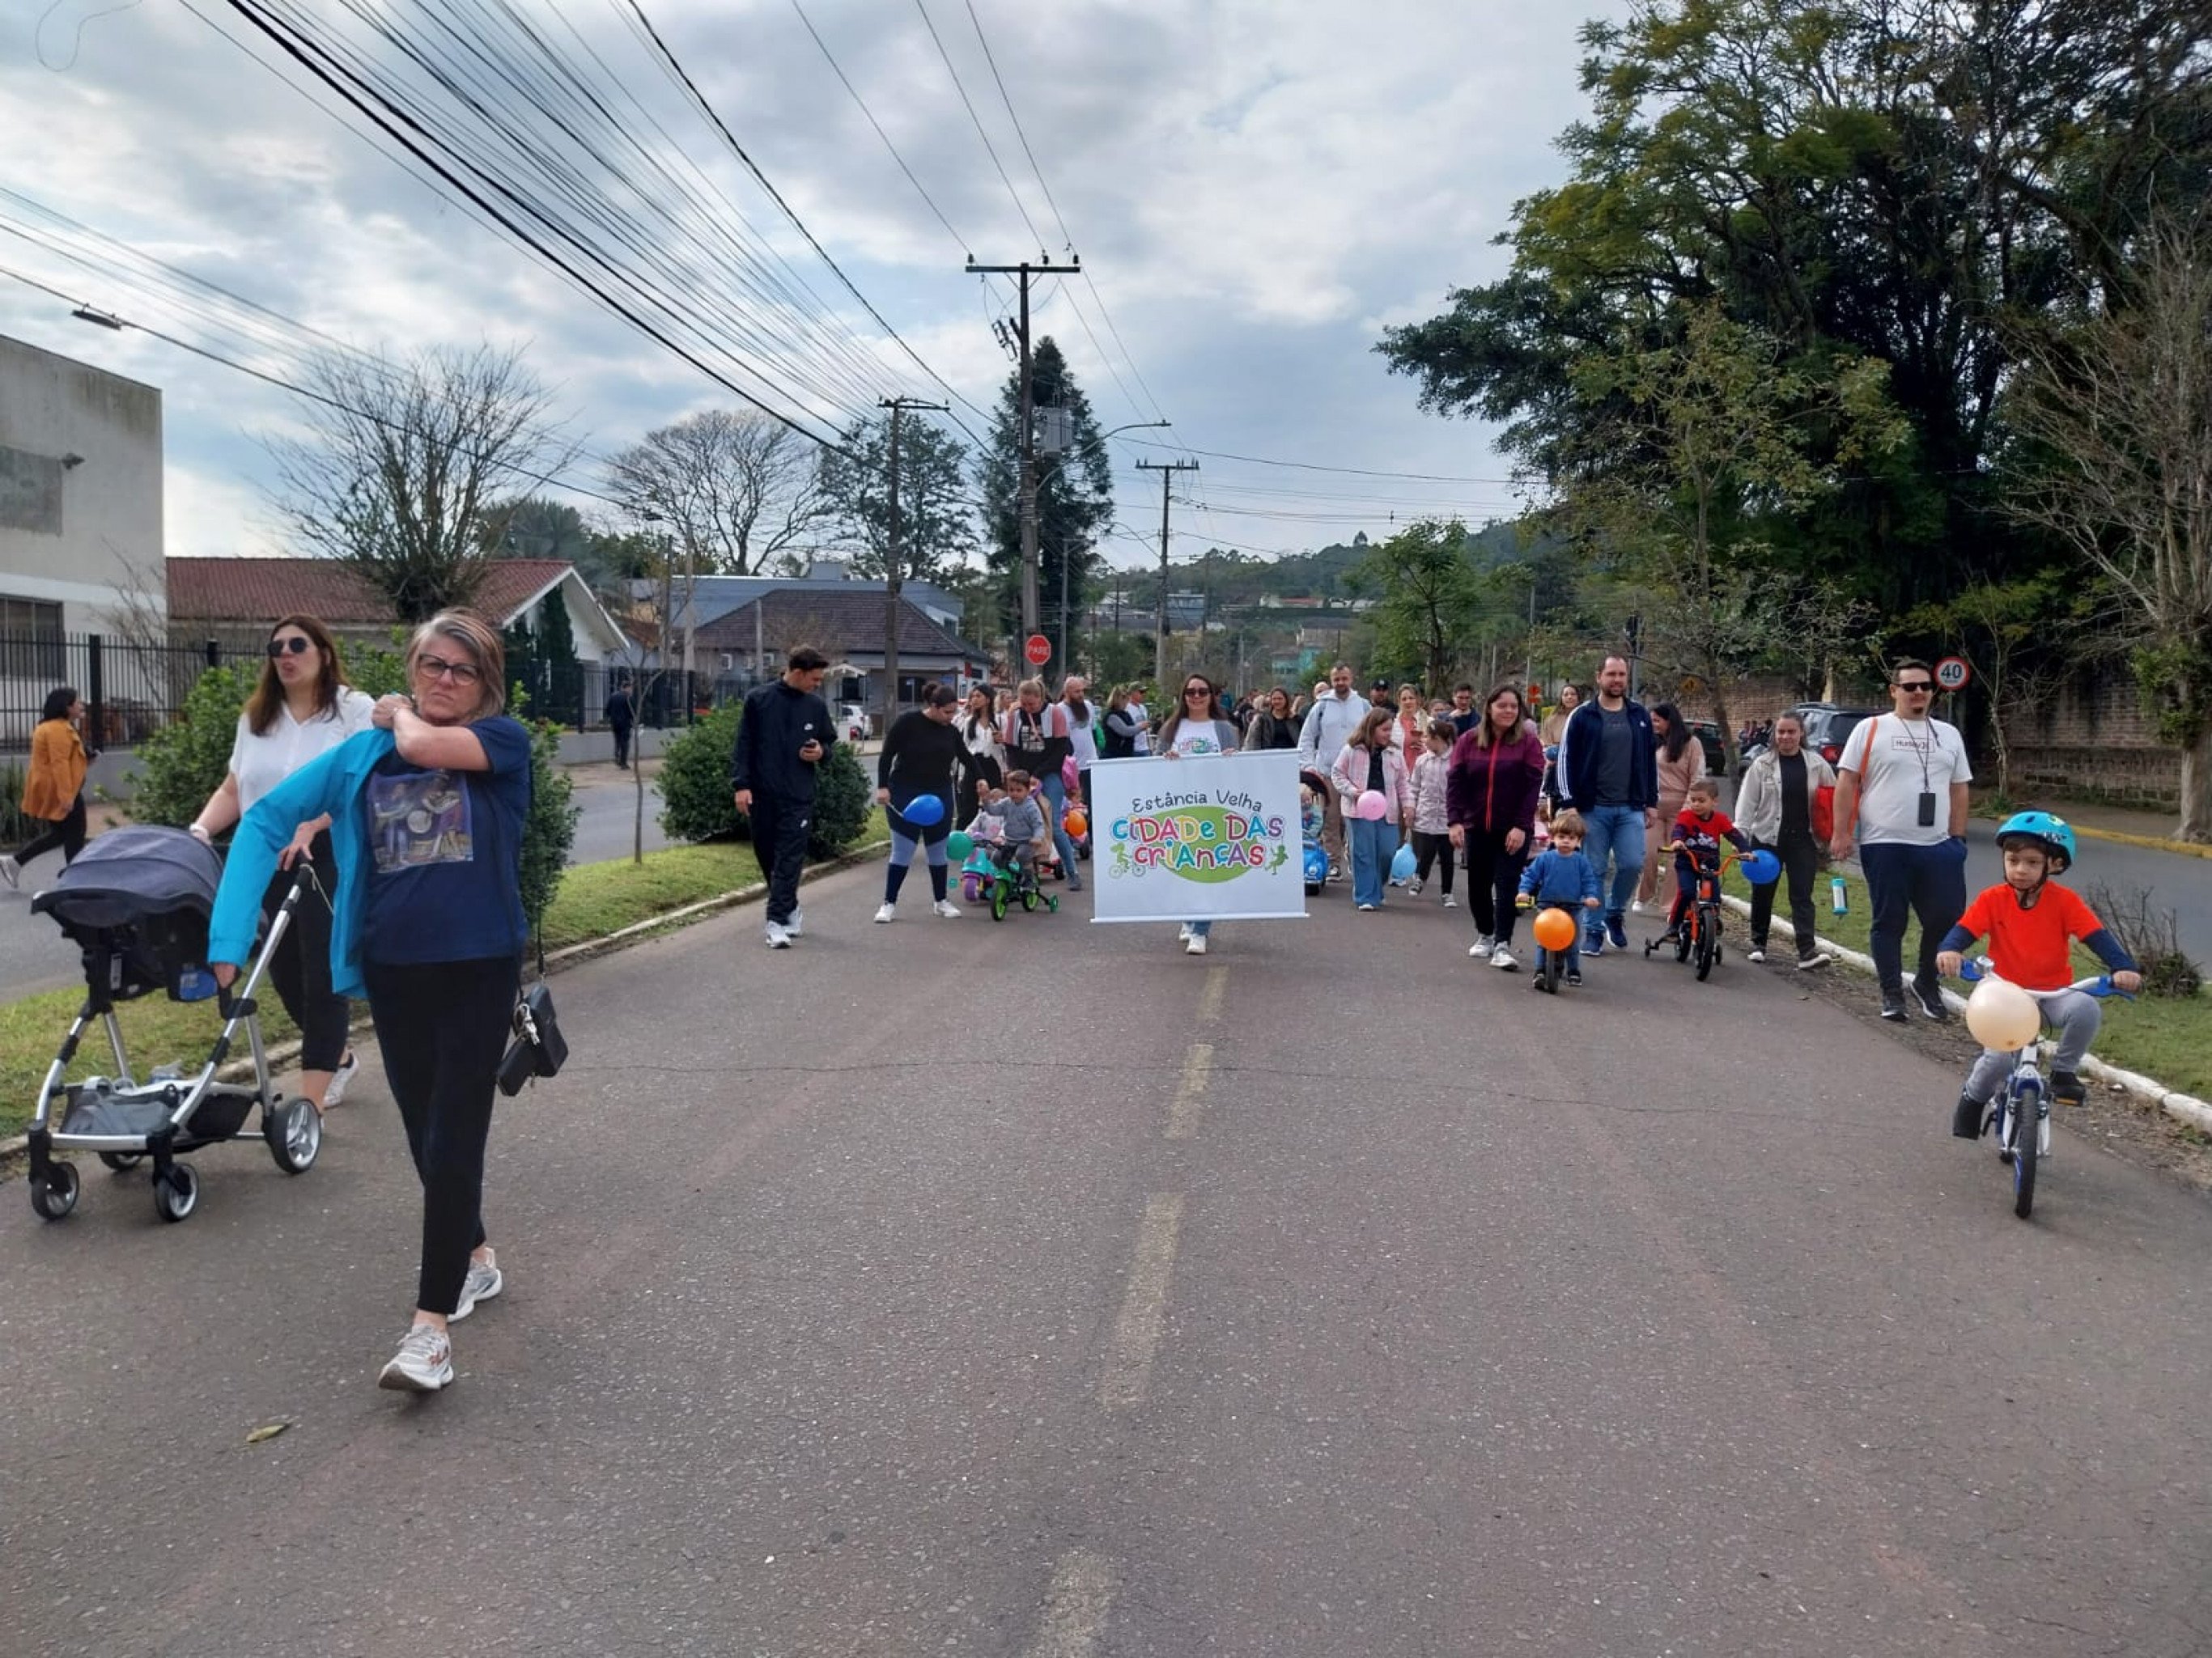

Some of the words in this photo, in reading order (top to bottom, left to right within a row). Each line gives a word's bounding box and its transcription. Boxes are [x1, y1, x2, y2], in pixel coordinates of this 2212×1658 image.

[1940, 664, 1962, 678] 40
[1132, 791, 1207, 812] Estância
[1216, 789, 1262, 812] Velha
[1224, 814, 1284, 841] DAS
